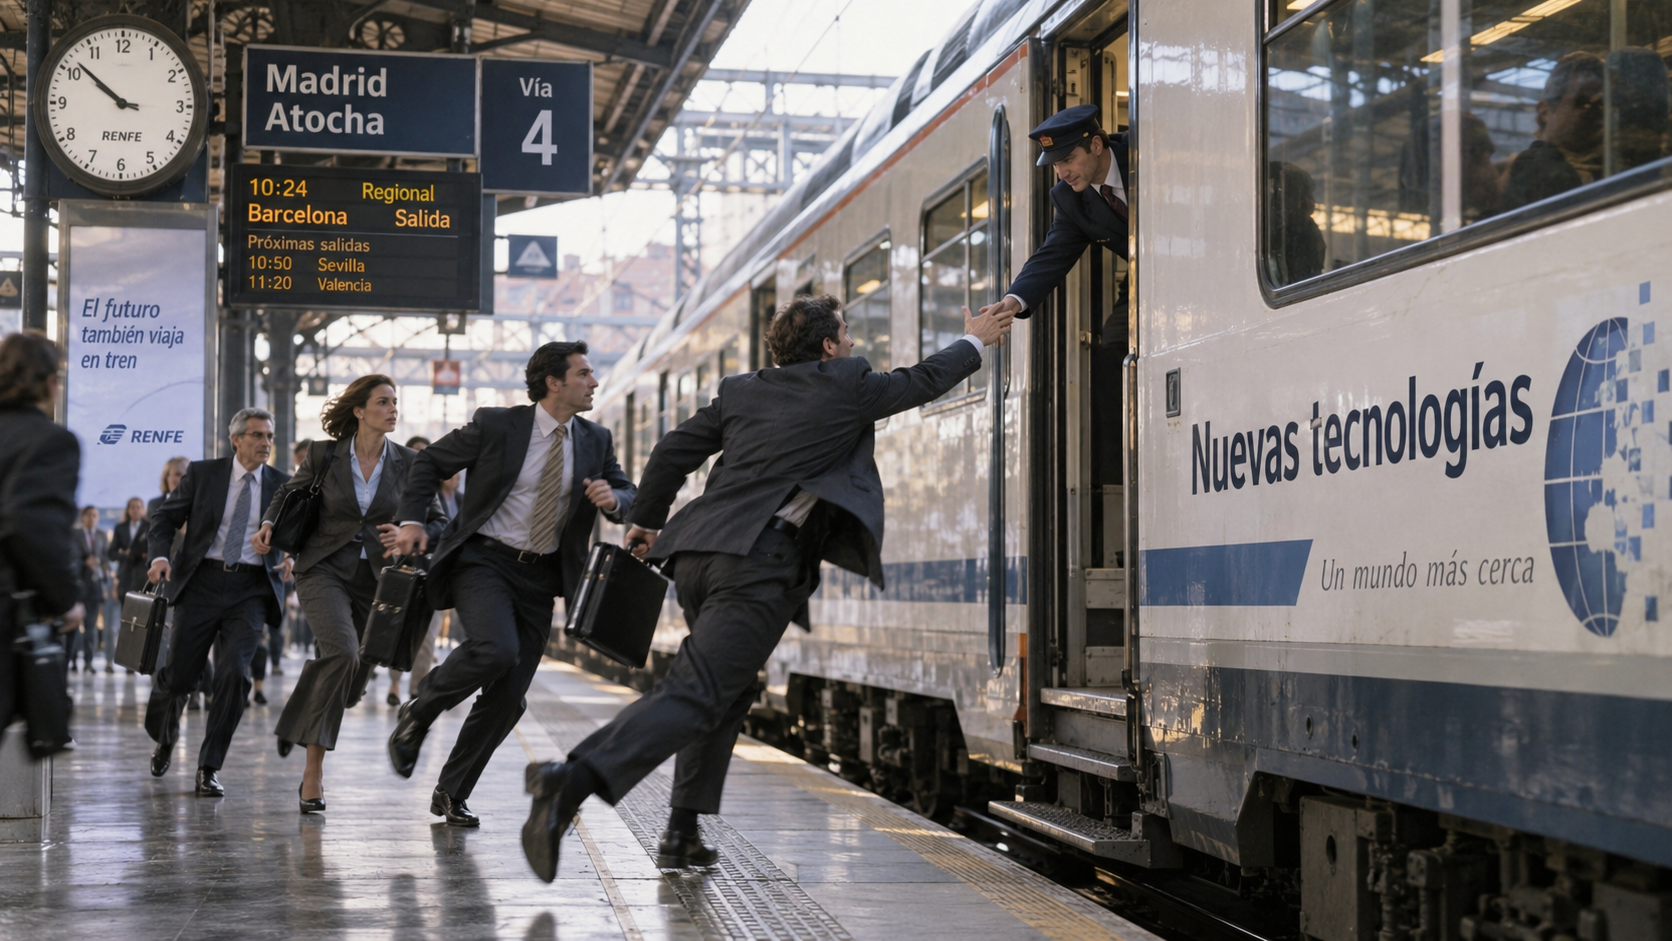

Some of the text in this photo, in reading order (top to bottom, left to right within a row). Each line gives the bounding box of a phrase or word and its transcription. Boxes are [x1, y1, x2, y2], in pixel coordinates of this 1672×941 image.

[88, 46, 100, 60] 11
[116, 39, 130, 53] 12
[148, 46, 155, 60] 1
[67, 67, 81, 80] 10
[167, 69, 176, 83] 2
[266, 63, 387, 98] Madrid
[519, 77, 553, 98] Vía
[58, 96, 67, 110] 9
[176, 100, 184, 113] 3
[264, 102, 385, 135] Atocha
[66, 127, 76, 141] 8
[101, 130, 143, 142] RENFE
[165, 129, 175, 143] 4
[521, 109, 558, 166] 4
[88, 149, 97, 163] 7
[146, 151, 155, 164] 5
[117, 158, 125, 171] 6
[249, 178, 435, 205] 10:24 Regional
[248, 203, 451, 229] Barcelona Salida
[248, 234, 370, 253] Próximas salidas
[249, 255, 365, 273] 10:50 Sevilla
[249, 274, 372, 292] 11:20 Valencia
[82, 298, 160, 322] El futuro
[82, 324, 184, 348] también viaja
[81, 351, 138, 369] en tren
[1191, 361, 1534, 496] Nuevas tecnologías
[130, 430, 185, 444] RENFE
[1321, 549, 1535, 592] Un mundo más cerca
